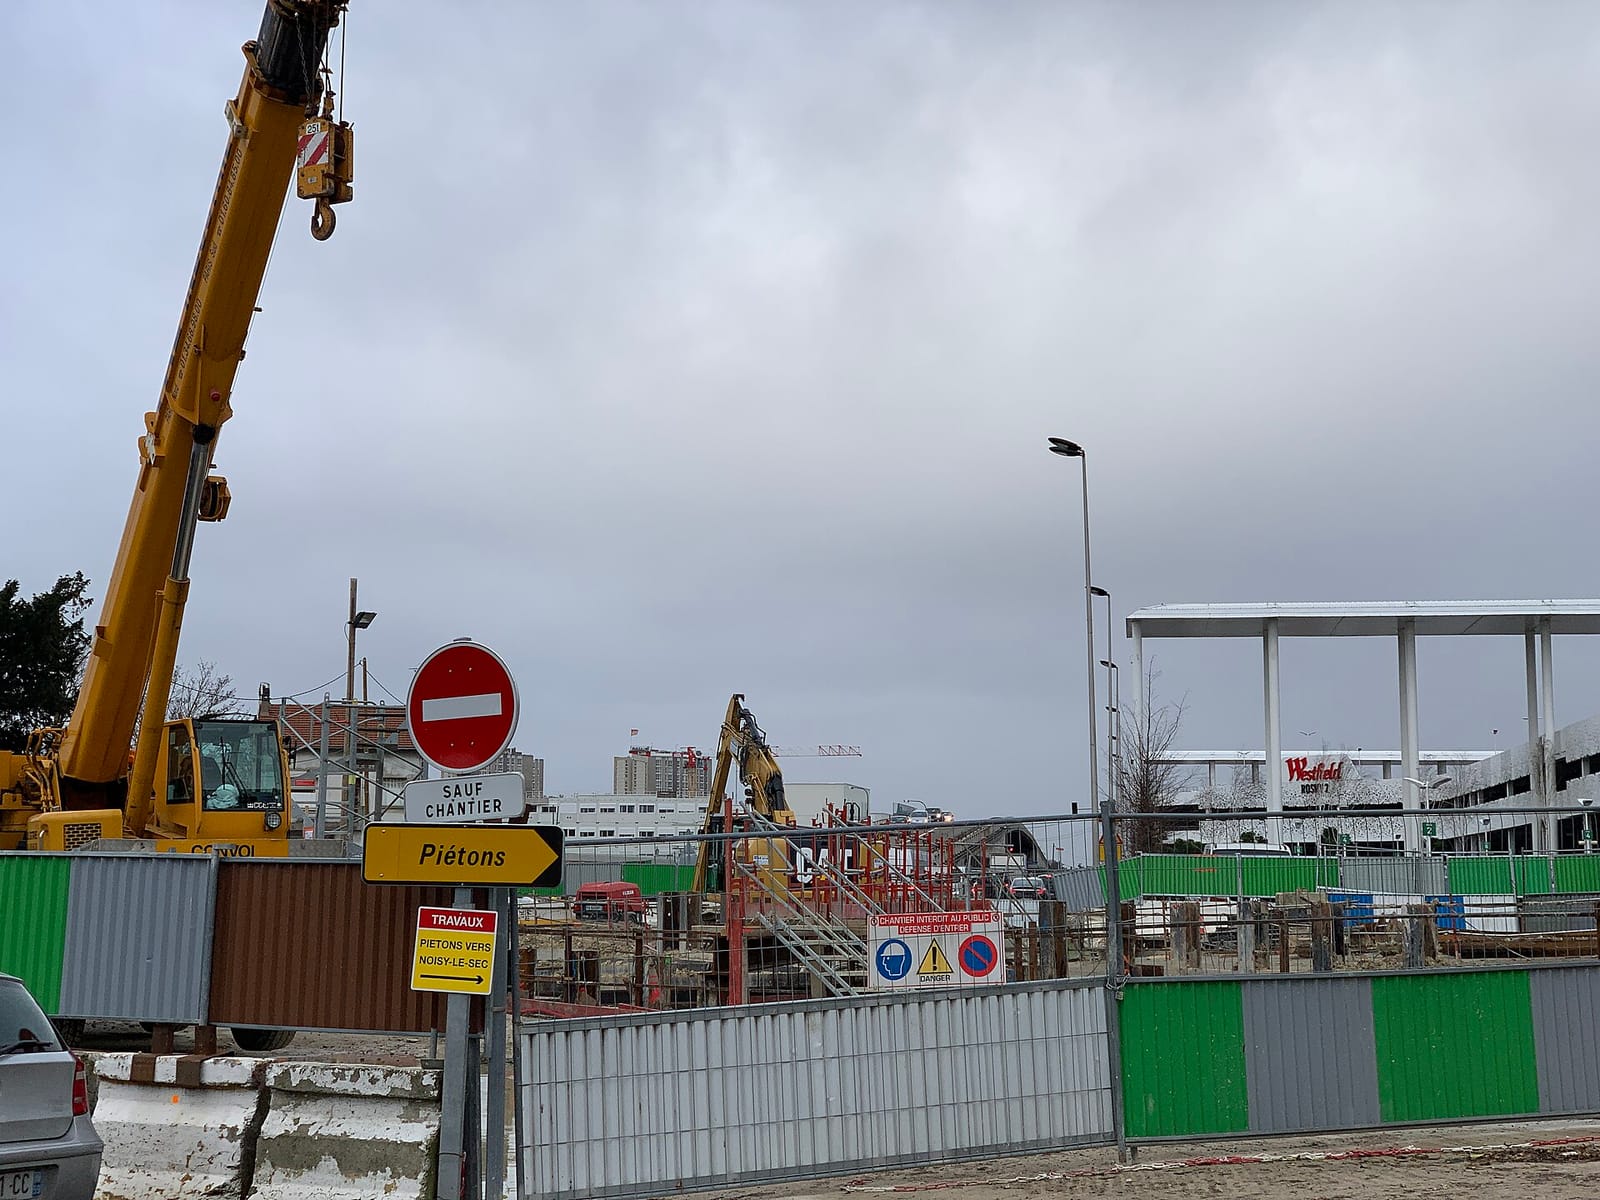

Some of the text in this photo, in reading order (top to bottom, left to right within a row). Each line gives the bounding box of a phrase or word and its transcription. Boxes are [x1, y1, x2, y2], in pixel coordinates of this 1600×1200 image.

[1285, 757, 1344, 782] Westfield
[443, 782, 483, 798] SAUF
[426, 799, 502, 818] CHANTIER
[419, 844, 506, 866] Piétons
[431, 914, 484, 928] TRAVAUX
[880, 913, 990, 925] CHANTIER INTERDIT AU PUBLIC
[899, 923, 969, 934] DEFENSE D'ENTRER
[420, 938, 491, 952] PIETONS VERS
[419, 955, 488, 969] NOISY-LE-SEC
[920, 974, 951, 983] DANGER
